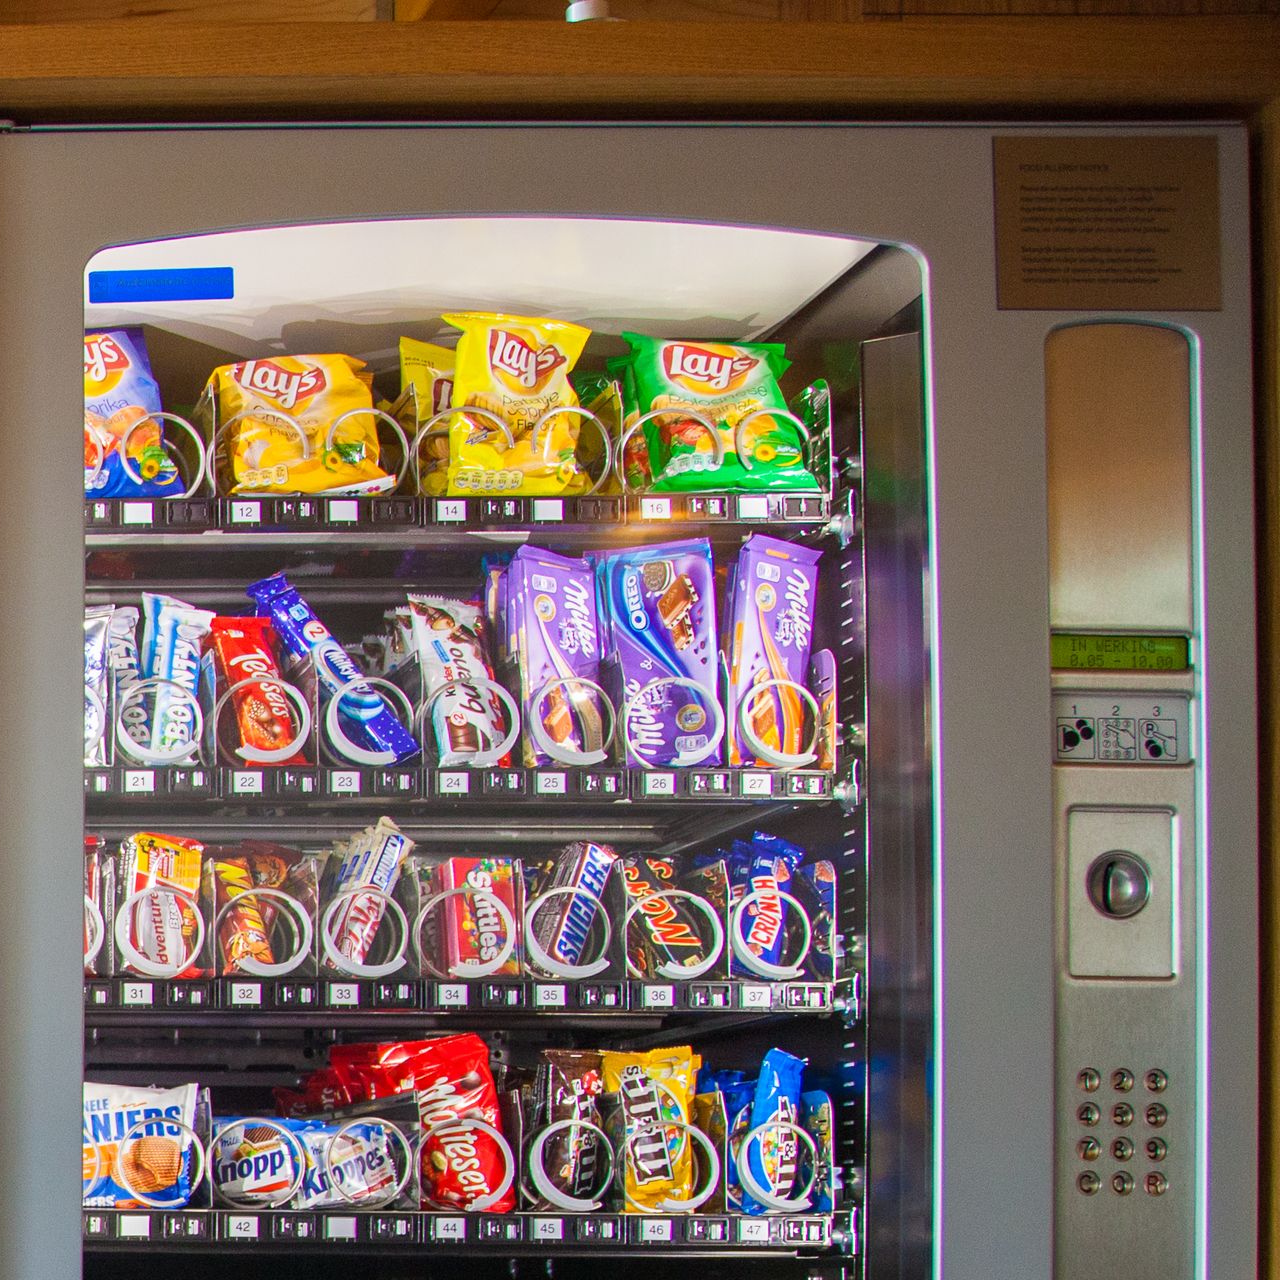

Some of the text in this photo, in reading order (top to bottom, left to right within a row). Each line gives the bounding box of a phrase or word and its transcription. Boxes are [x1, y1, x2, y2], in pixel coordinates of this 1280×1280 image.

[85, 336, 121, 381] y's
[492, 331, 555, 387] Lay's
[670, 346, 752, 389] Lay's
[241, 361, 317, 409] Lay's
[239, 507, 253, 517] 12
[444, 505, 459, 516] 14
[649, 503, 663, 514] 16
[626, 575, 647, 630] OREO
[784, 568, 811, 652] Milka
[563, 578, 596, 657] Milka
[1071, 705, 1161, 717] 1 2 3
[132, 776, 146, 787] 21
[240, 777, 255, 788] 22
[337, 776, 353, 787] 23
[446, 777, 461, 788] 24
[543, 777, 559, 788] 25
[651, 779, 667, 789] 26
[749, 779, 765, 789] 27
[151, 890, 169, 966] dventure
[130, 988, 144, 999] 31
[238, 988, 254, 999] 32
[336, 989, 351, 999] 33
[444, 990, 460, 1000] 34
[542, 990, 558, 1000] 35
[651, 991, 666, 1001] 36
[749, 992, 763, 1002] 37
[1081, 1072, 1159, 1091] 1 2 3
[1080, 1107, 1159, 1125] 4 5 6
[1081, 1141, 1159, 1160] 7 8 9
[235, 1221, 251, 1232] 42
[442, 1222, 458, 1233] 44
[539, 1223, 555, 1234] 45
[649, 1224, 664, 1235] 46
[746, 1225, 762, 1235] 47
